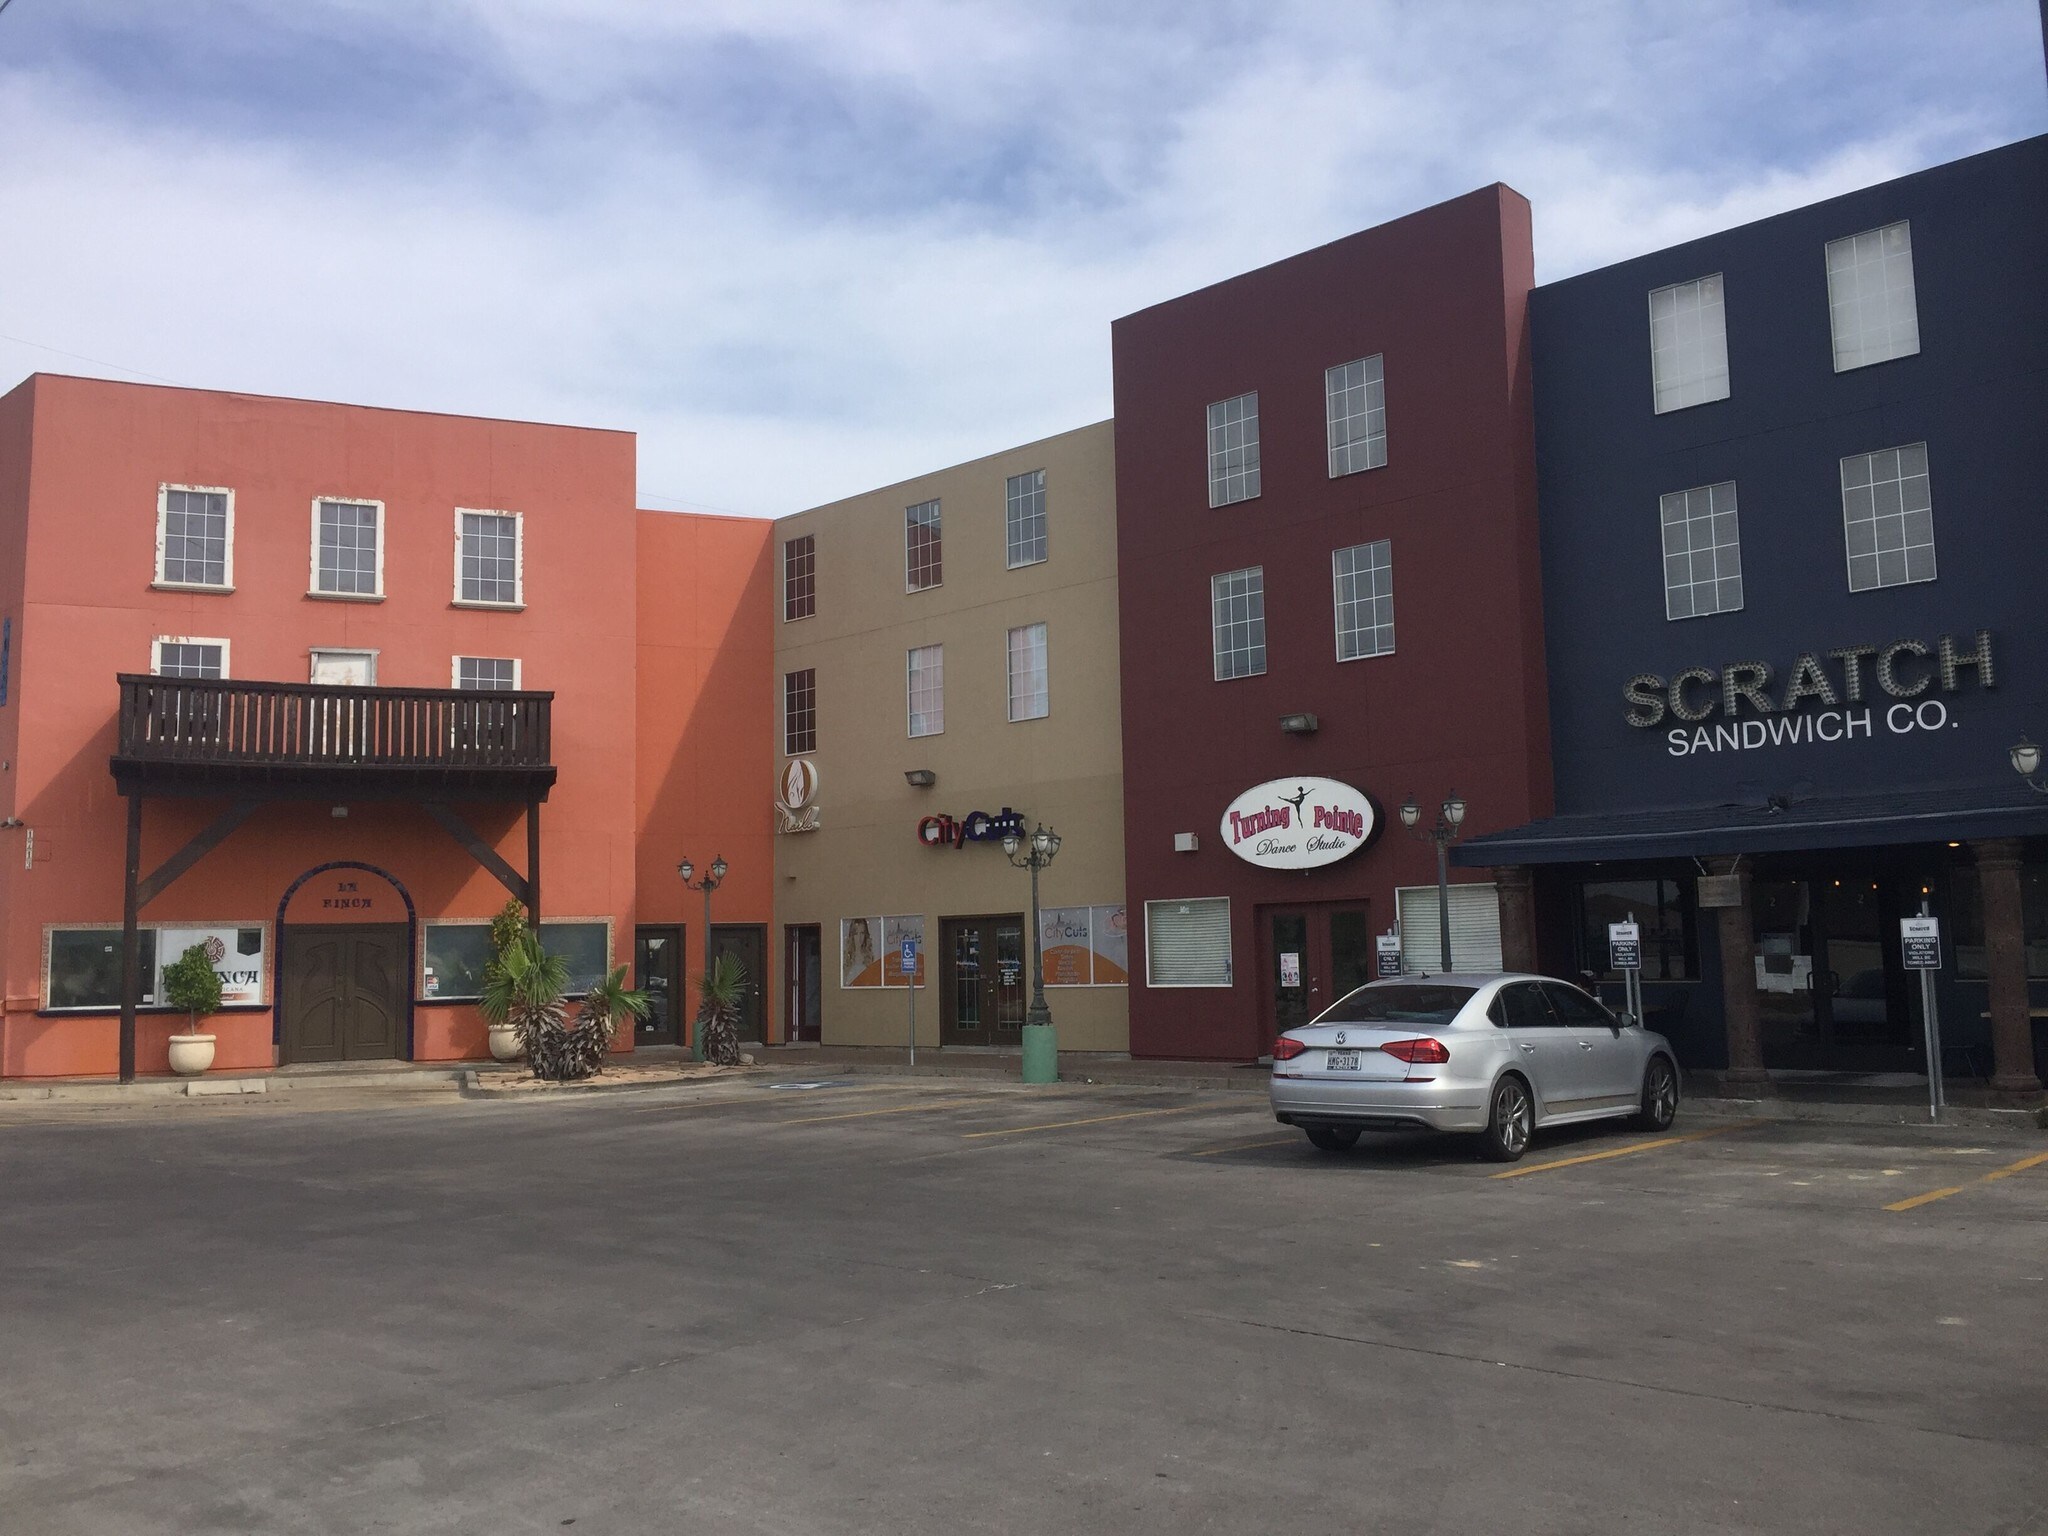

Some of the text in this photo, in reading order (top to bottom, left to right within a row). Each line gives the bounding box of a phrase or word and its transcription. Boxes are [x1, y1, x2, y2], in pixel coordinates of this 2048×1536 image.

[1622, 629, 1995, 728] SCRATCH
[1668, 700, 1959, 757] SANDWICH CO.
[775, 801, 820, 834] Nails
[1229, 805, 1363, 845] Turning Pointe
[1256, 834, 1347, 856] Dance Studio
[1045, 927, 1088, 939] CityCuts
